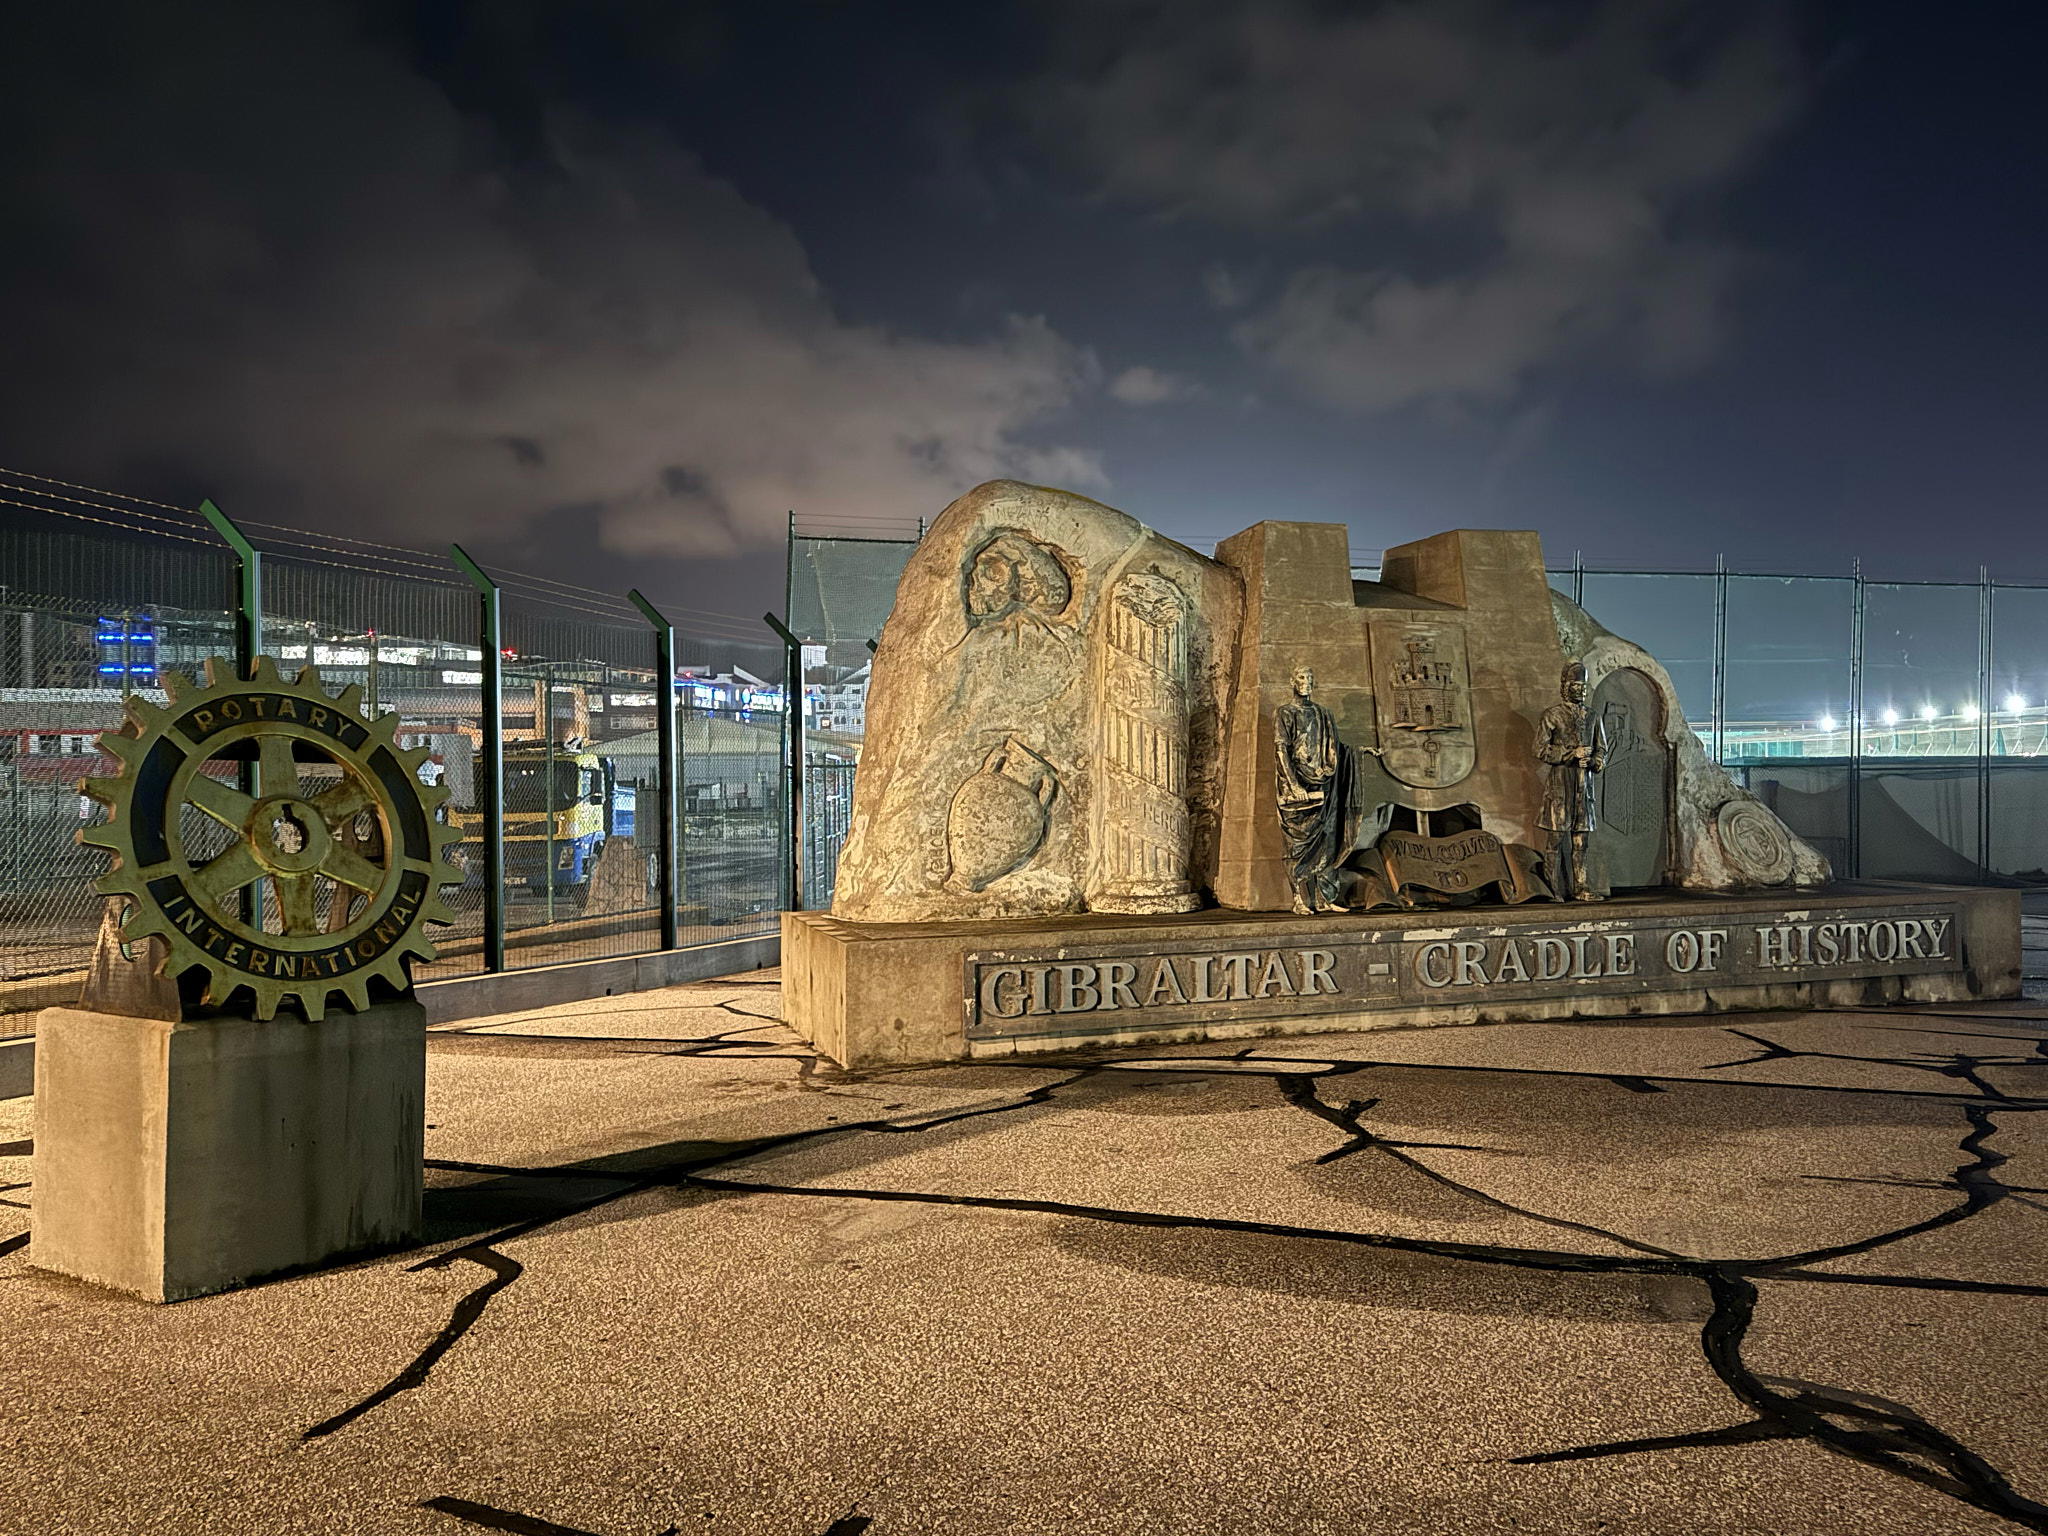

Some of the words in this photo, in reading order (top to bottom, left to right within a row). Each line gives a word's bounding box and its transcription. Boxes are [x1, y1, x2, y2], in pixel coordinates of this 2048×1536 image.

[193, 696, 353, 739] ROTARY
[1391, 834, 1498, 865] WELCOME
[1434, 868, 1468, 889] TO
[162, 889, 422, 978] INTERNATIONAL
[981, 949, 1341, 1019] GIBRALTAR
[1415, 934, 1637, 989] CRADLE
[1666, 928, 1728, 975] OF
[1756, 917, 1952, 969] HISTORY
